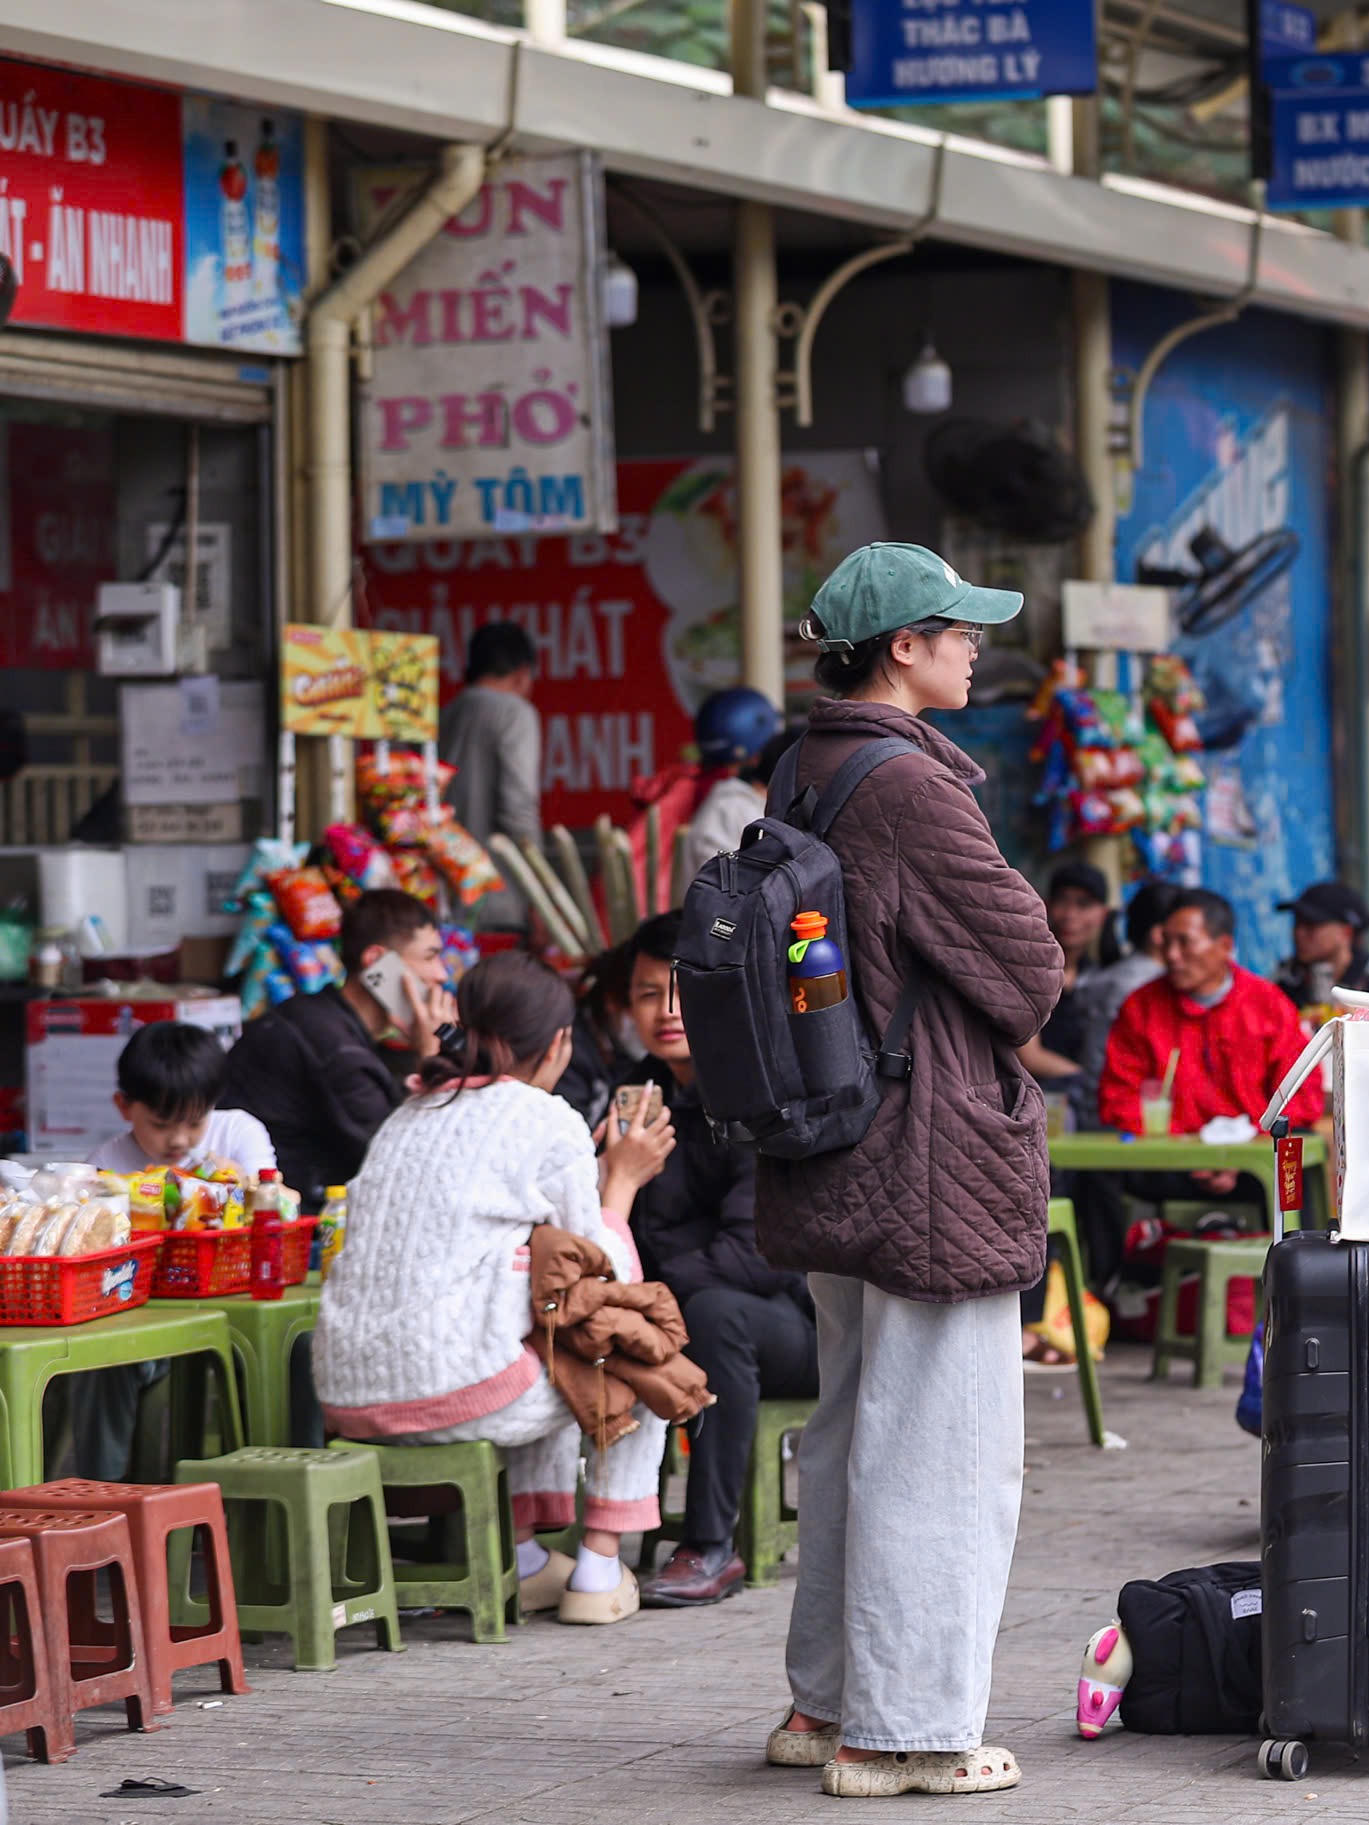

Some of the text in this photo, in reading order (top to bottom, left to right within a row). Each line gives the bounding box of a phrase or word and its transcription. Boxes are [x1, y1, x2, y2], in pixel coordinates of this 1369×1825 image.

[67, 112, 107, 166] B3
[1297, 111, 1340, 144] BX
[88, 208, 172, 304] NHANH
[374, 260, 574, 345] MIẾN
[377, 367, 578, 450] PHỞ
[473, 466, 585, 525] TÔM
[543, 712, 654, 790] ANH
